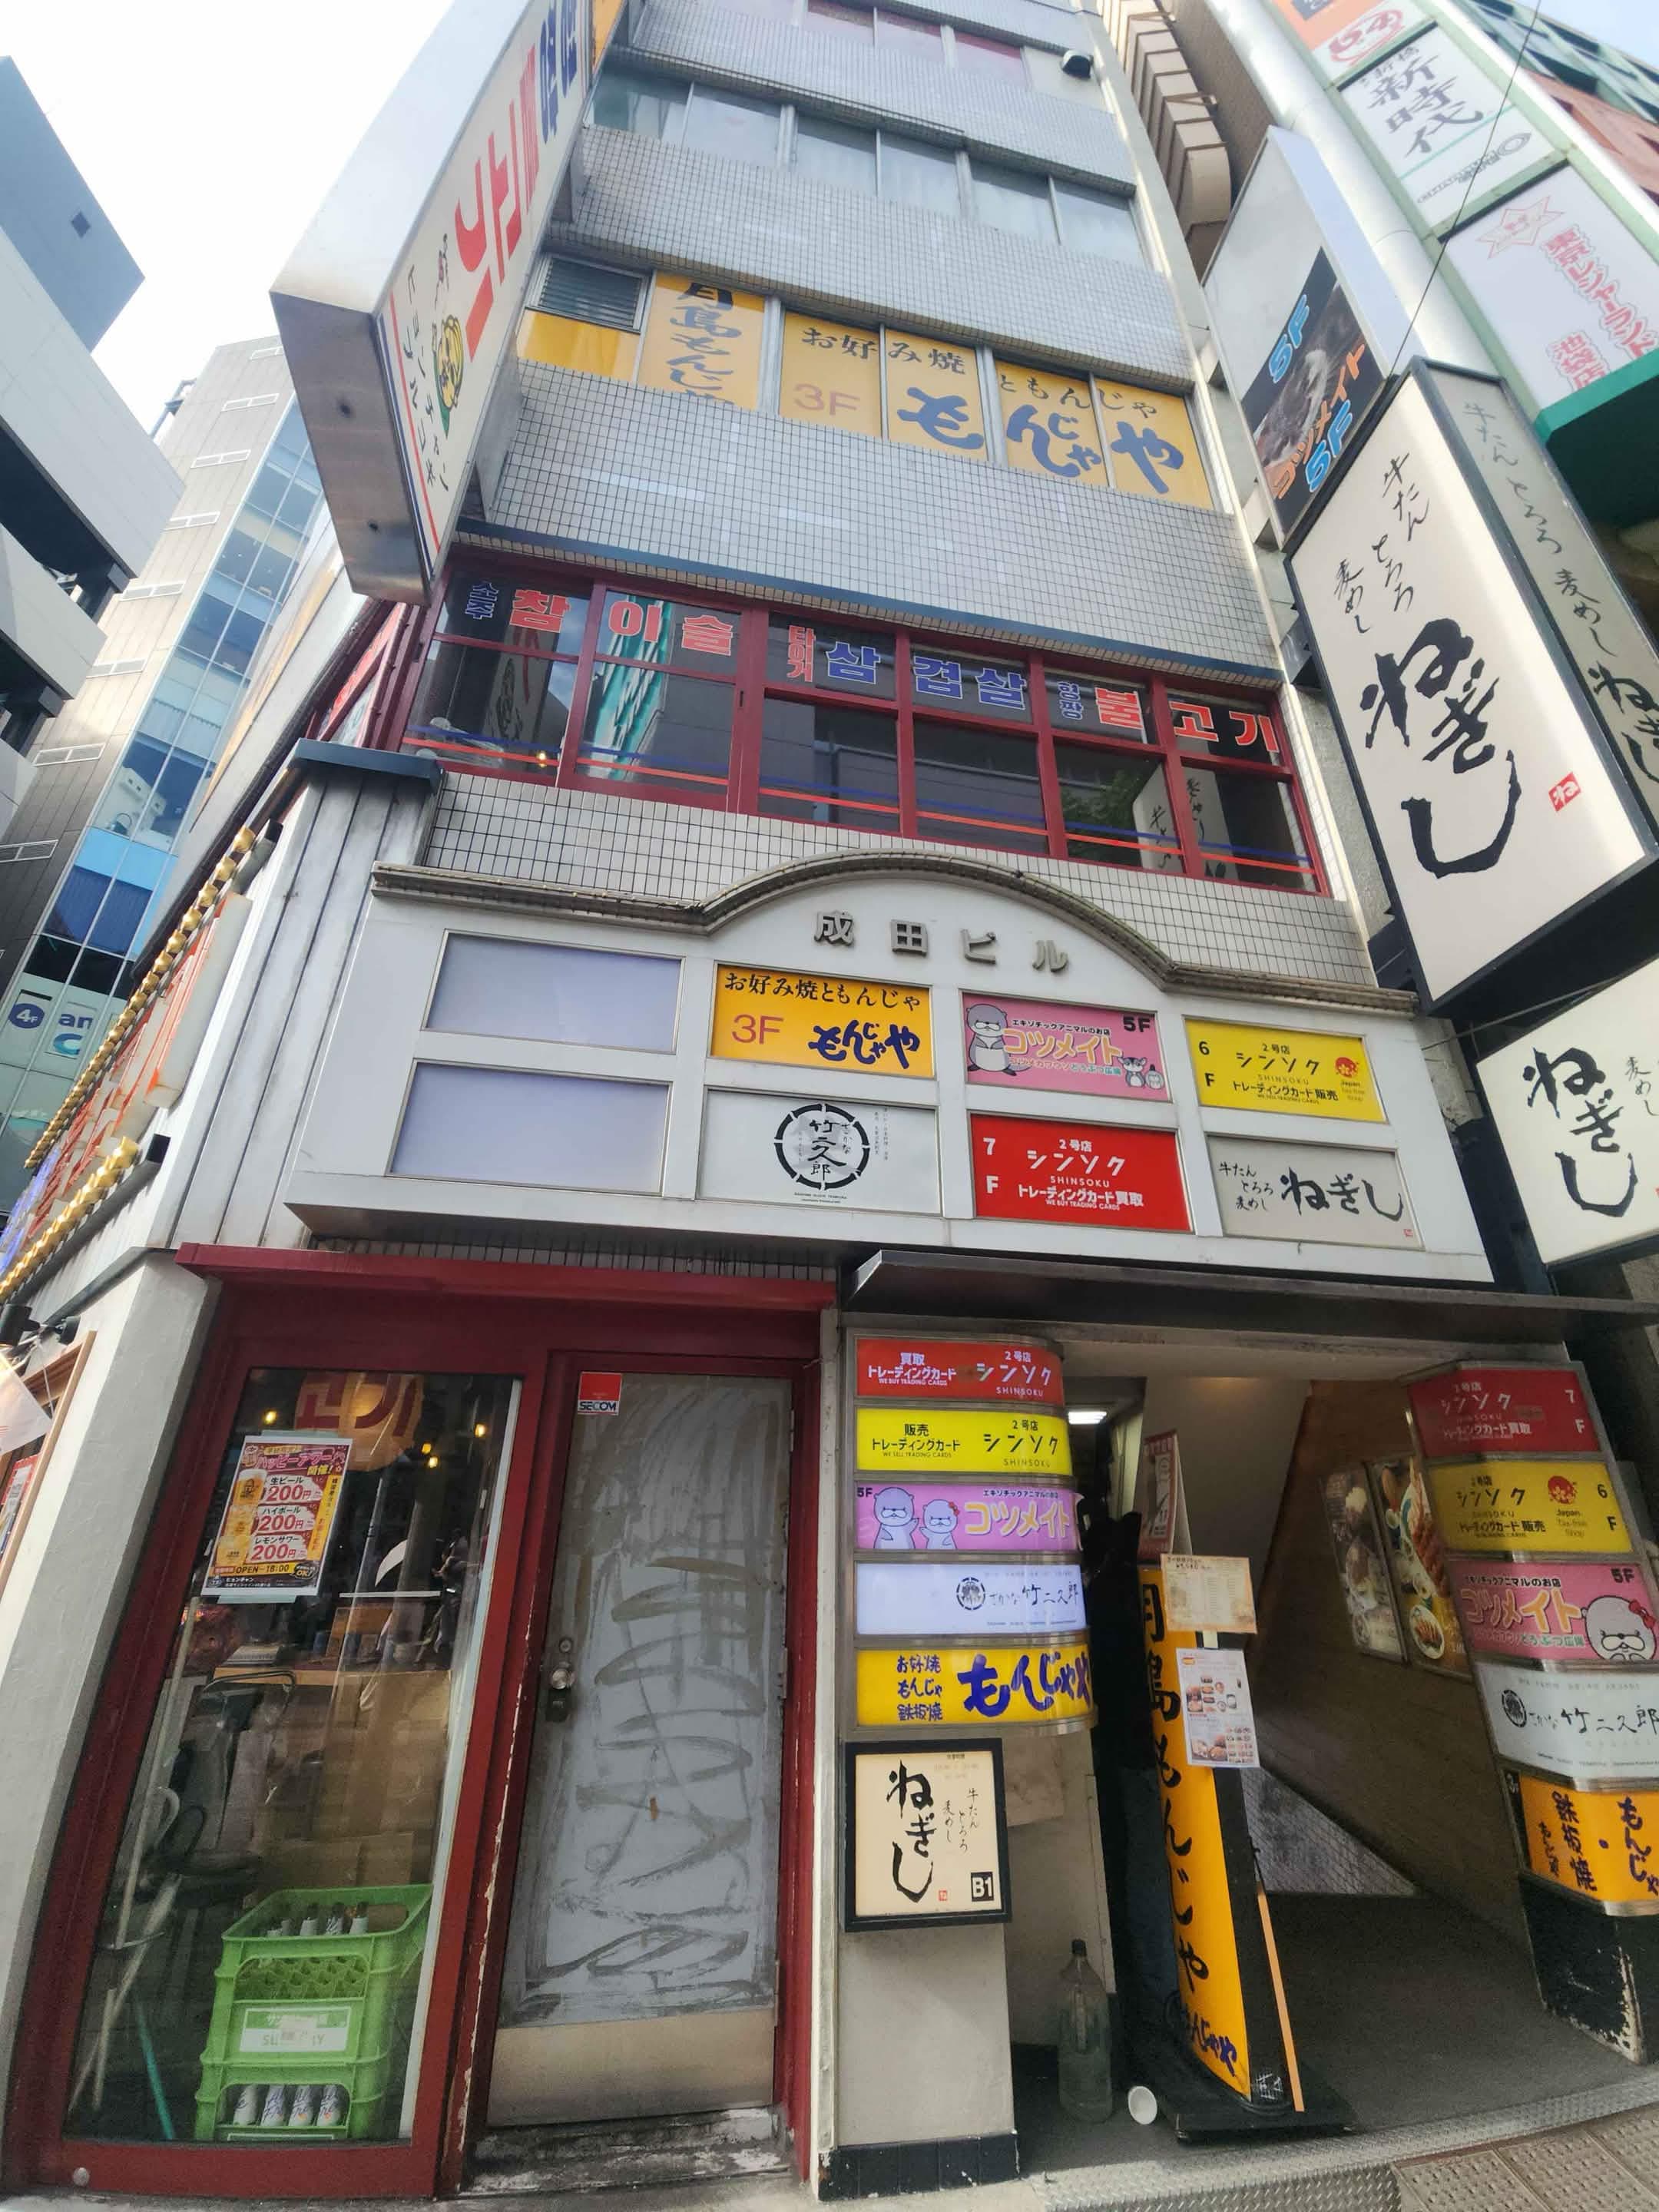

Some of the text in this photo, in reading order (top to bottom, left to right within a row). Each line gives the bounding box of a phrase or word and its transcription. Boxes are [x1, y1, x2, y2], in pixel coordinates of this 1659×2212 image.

[1367, 54, 1484, 159] 新時代
[800, 325, 1159, 419] お好み焼ともんじゃ
[793, 382, 860, 416] 3F
[1380, 452, 1431, 542] 牛たん
[1094, 686, 1281, 753] 불고기
[1359, 617, 1523, 880] ねぎし
[813, 908, 1069, 974] 成田ビル
[724, 971, 922, 1012] お好み焼ともんじゃ
[731, 1012, 785, 1045] 3F
[1012, 1018, 1111, 1036] エキゾチックアニマルのお店
[1122, 1016, 1151, 1033] 5F
[808, 1019, 921, 1070] もんじゃや
[1002, 1028, 1123, 1065] コツメイト
[1262, 1043, 1291, 1055] 2号店
[1236, 1051, 1320, 1075] シンソク
[1258, 1075, 1310, 1085] SHINSOKU
[1522, 1045, 1638, 1217] ねぎし
[1058, 1138, 1093, 1153] 2号店
[1027, 1150, 1125, 1177] シンソク
[1218, 1161, 1257, 1178] 牛たん
[1050, 1175, 1111, 1188] SHINSOKU
[1240, 1180, 1273, 1196] とろろ
[1235, 1195, 1269, 1211] 麦めし
[1279, 1167, 1405, 1223] ねぎし
[900, 1352, 926, 1366] 買取
[1004, 1350, 1031, 1363] 2号店
[867, 1365, 957, 1380] トレーディングカード
[975, 1362, 1051, 1386] シンソク
[995, 1386, 1044, 1397] SHINSOKU
[579, 1401, 617, 1411] SECOM
[904, 1423, 930, 1437] 販売
[1012, 1419, 1038, 1432] 2号店
[872, 1437, 961, 1452] トレーディングカード
[983, 1433, 1059, 1455] シンソク
[1003, 1458, 1051, 1469] SHINSOKU
[270, 1476, 305, 1485] 生ビール
[266, 1485, 311, 1502] 200円
[856, 1487, 873, 1498] 5F
[262, 1506, 302, 1515] ハイボール
[963, 1500, 1071, 1539] コツメイト
[257, 1514, 304, 1532] 200円
[255, 1536, 300, 1545] レモンサワー
[250, 1543, 296, 1561] 200円
[1611, 1568, 1634, 1584] 5F
[896, 1654, 942, 1673] お好焼
[897, 1677, 942, 1699] もんじゃ
[956, 1651, 1091, 1717] もんじゃや
[897, 1701, 943, 1722] 鉄板焼
[886, 1757, 938, 1904] ねぎし
[972, 1876, 993, 1898] B1
